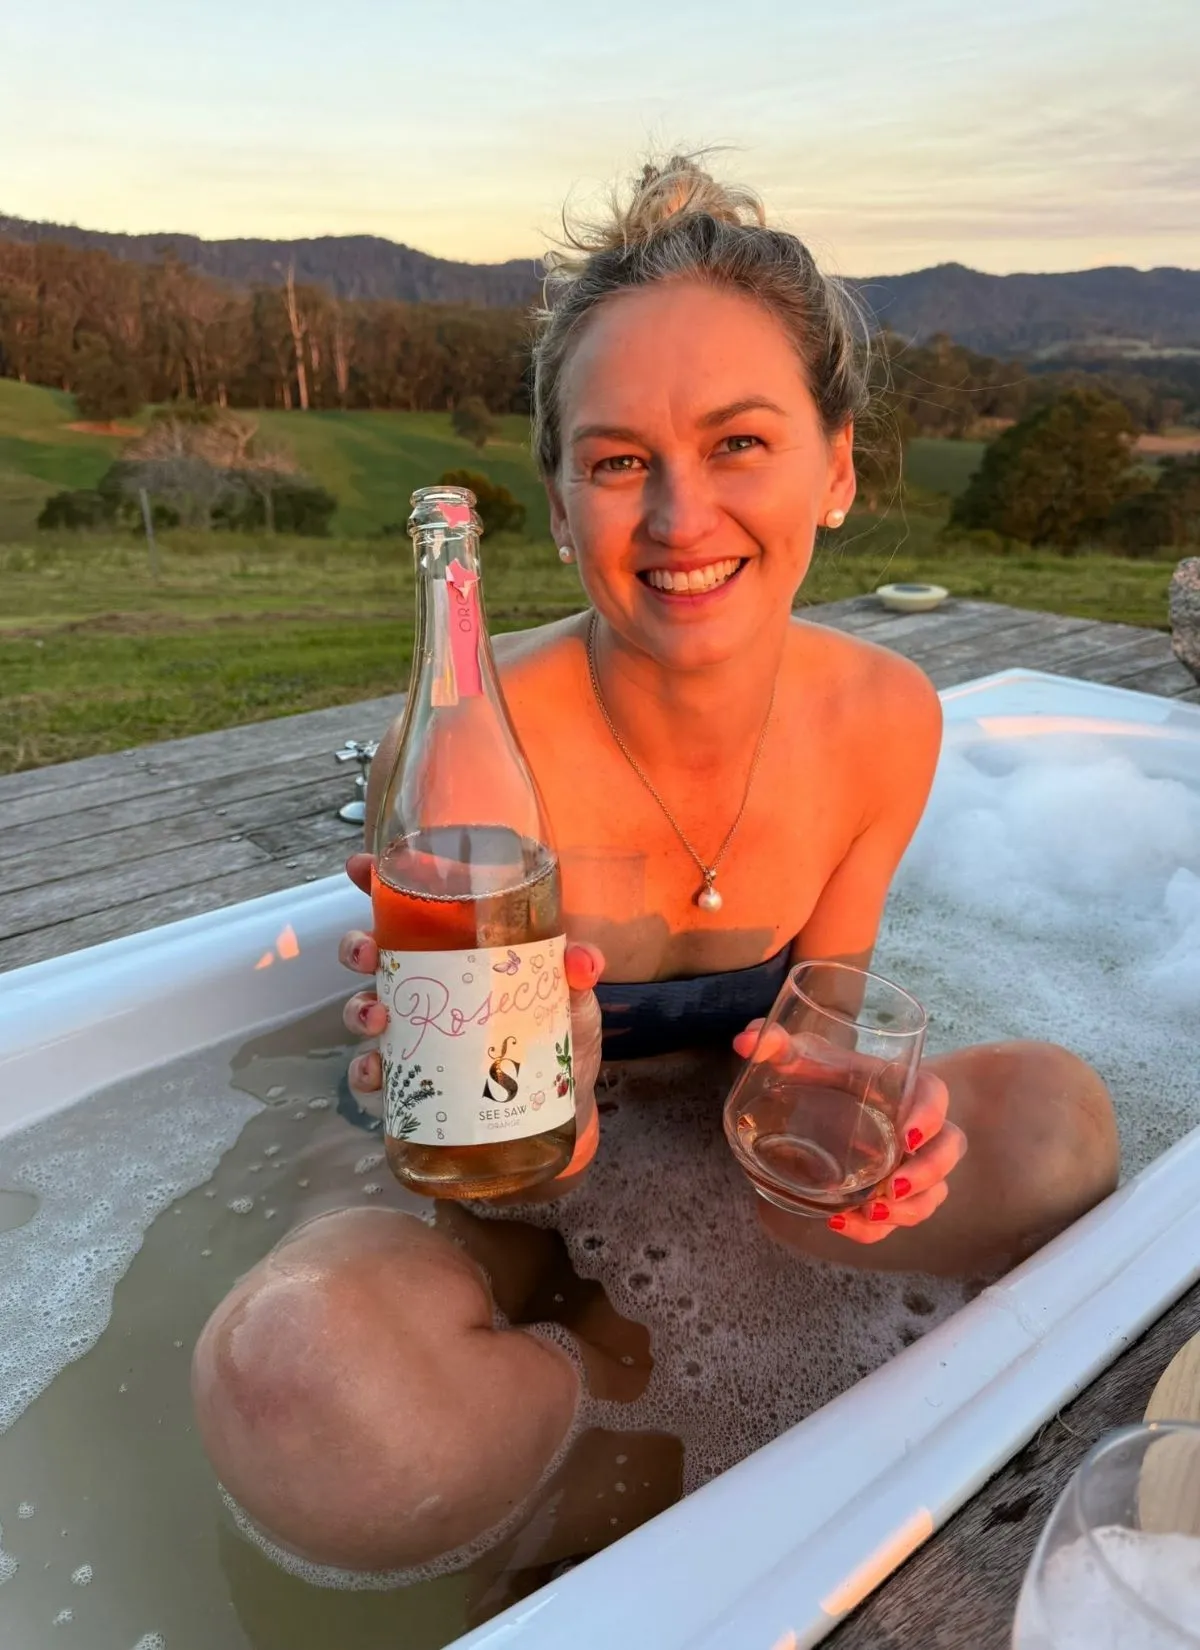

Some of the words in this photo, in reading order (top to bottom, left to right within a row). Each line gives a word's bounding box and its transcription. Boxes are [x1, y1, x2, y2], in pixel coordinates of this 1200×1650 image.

[393, 966, 561, 1060] Rosecco
[478, 1109, 500, 1121] SEE
[503, 1104, 527, 1118] SAW
